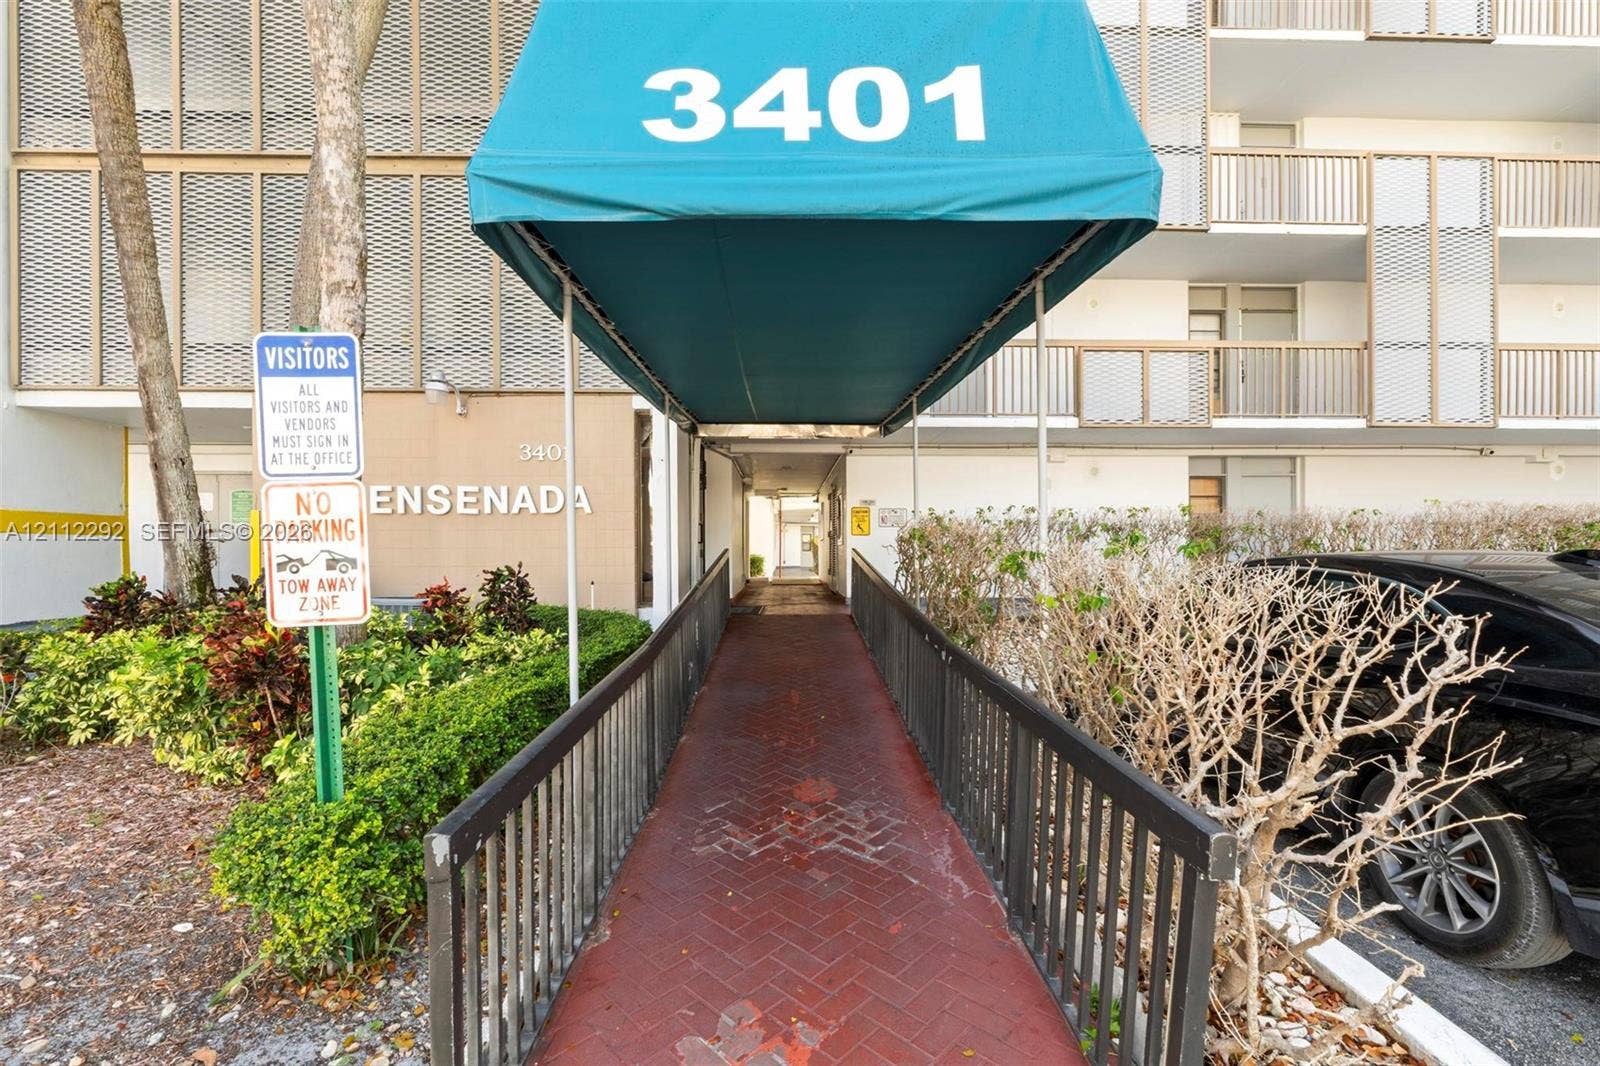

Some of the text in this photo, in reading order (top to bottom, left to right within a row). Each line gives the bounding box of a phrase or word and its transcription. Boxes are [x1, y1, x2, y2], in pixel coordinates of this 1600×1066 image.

[642, 65, 986, 142] 3401
[265, 346, 349, 369] VISITORS
[298, 384, 319, 396] ALL
[270, 400, 348, 413] VISITORS AND
[284, 417, 336, 431] VENDORS
[272, 433, 349, 448] MUST SIGN IN
[270, 451, 353, 466] AT THE OFFICE
[295, 491, 331, 516] NO
[369, 485, 592, 515] ENSENADA
[278, 577, 357, 595] TOW AWAY
[299, 595, 341, 612] ZONE
